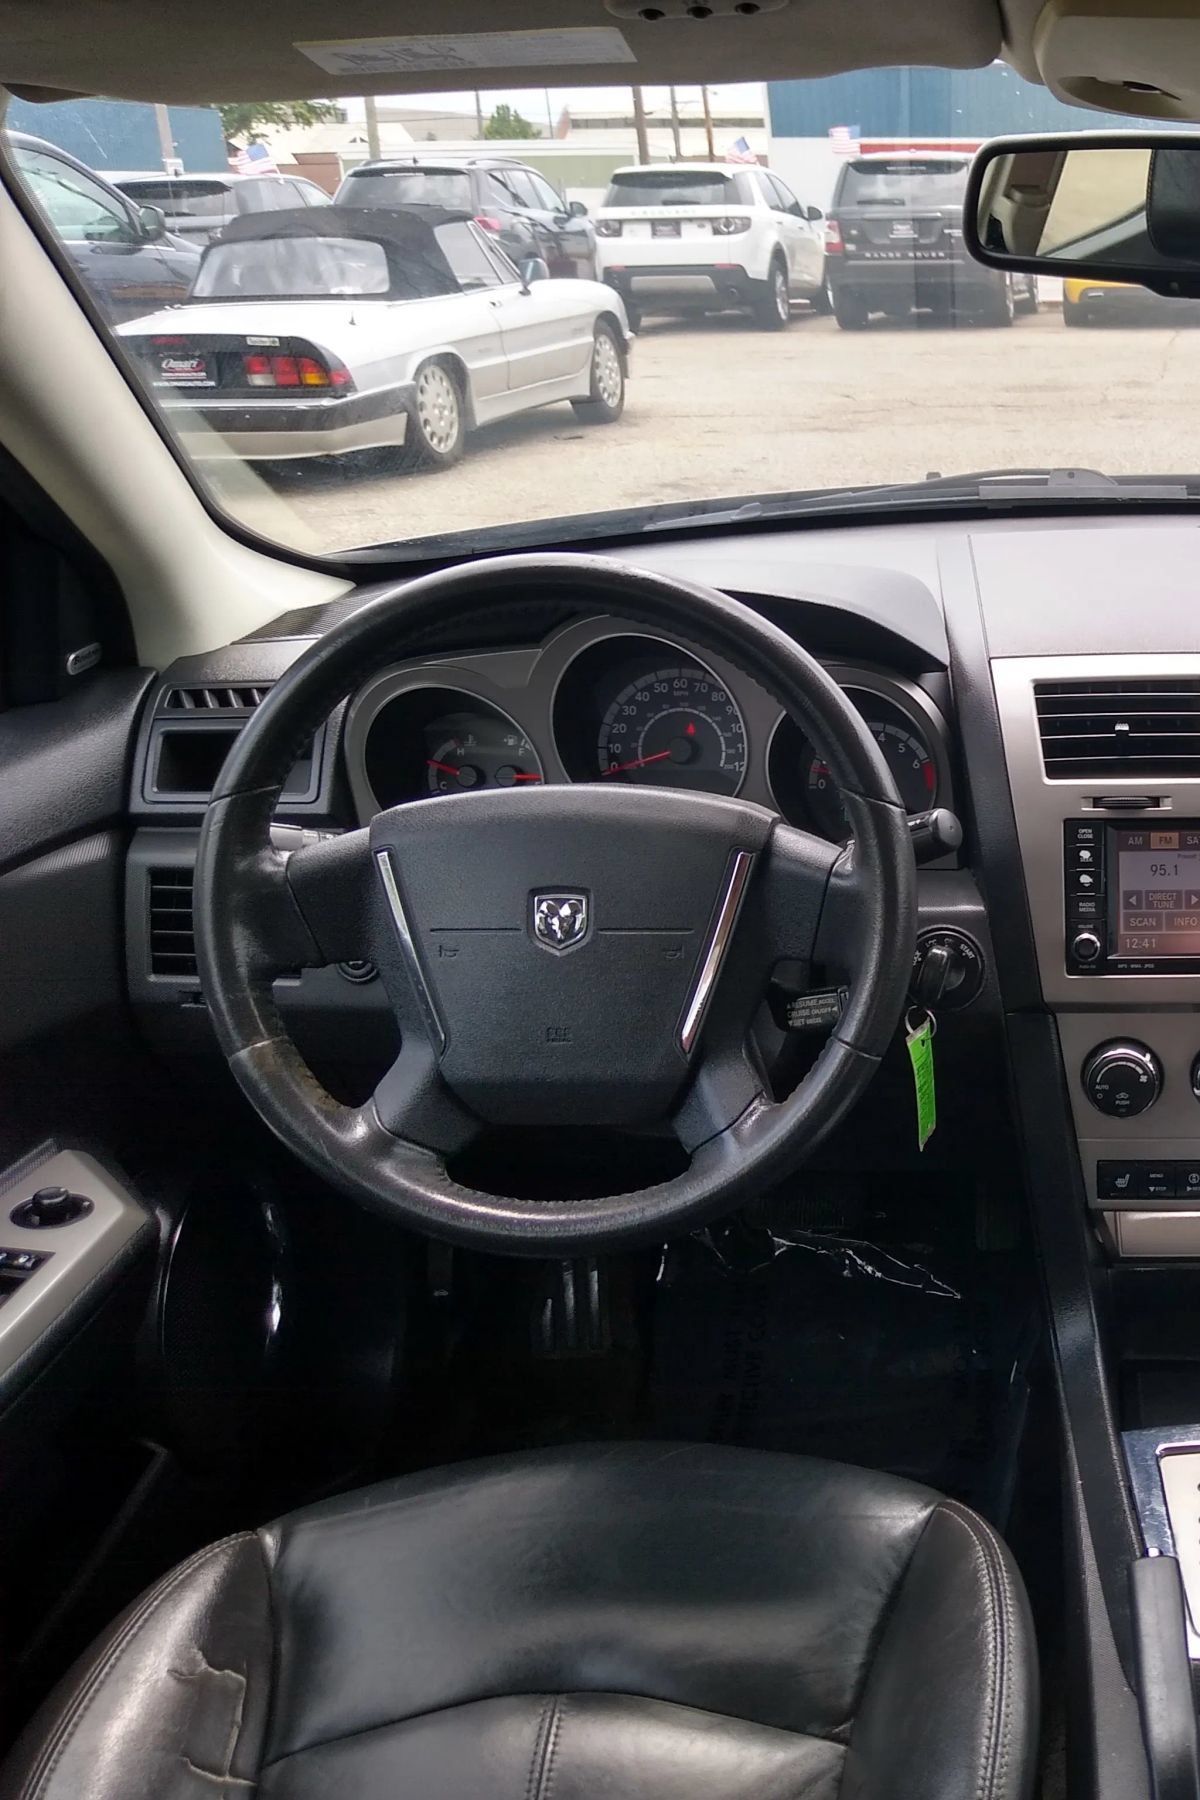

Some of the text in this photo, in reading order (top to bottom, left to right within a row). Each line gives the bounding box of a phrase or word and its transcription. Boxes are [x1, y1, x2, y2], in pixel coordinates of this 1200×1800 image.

[653, 683, 668, 693] 50
[673, 678, 688, 688] 60
[694, 682, 708, 693] 70
[635, 691, 650, 701] 40
[711, 691, 726, 702] 80
[622, 705, 637, 715] 30
[612, 723, 627, 733] 20
[518, 748, 525, 756] F
[609, 743, 621, 753] 10
[898, 743, 906, 753] 5
[912, 760, 920, 769] 6
[440, 781, 447, 790] C
[818, 779, 826, 789] 0
[1128, 837, 1143, 845] AM
[1159, 836, 1172, 844] FM
[1150, 864, 1178, 877] 95.1
[1149, 893, 1177, 901] DIRECT
[1129, 918, 1157, 927] SCAN
[1174, 917, 1198, 926] INFO
[1125, 938, 1156, 949] 12:41
[960, 944, 975, 959] START
